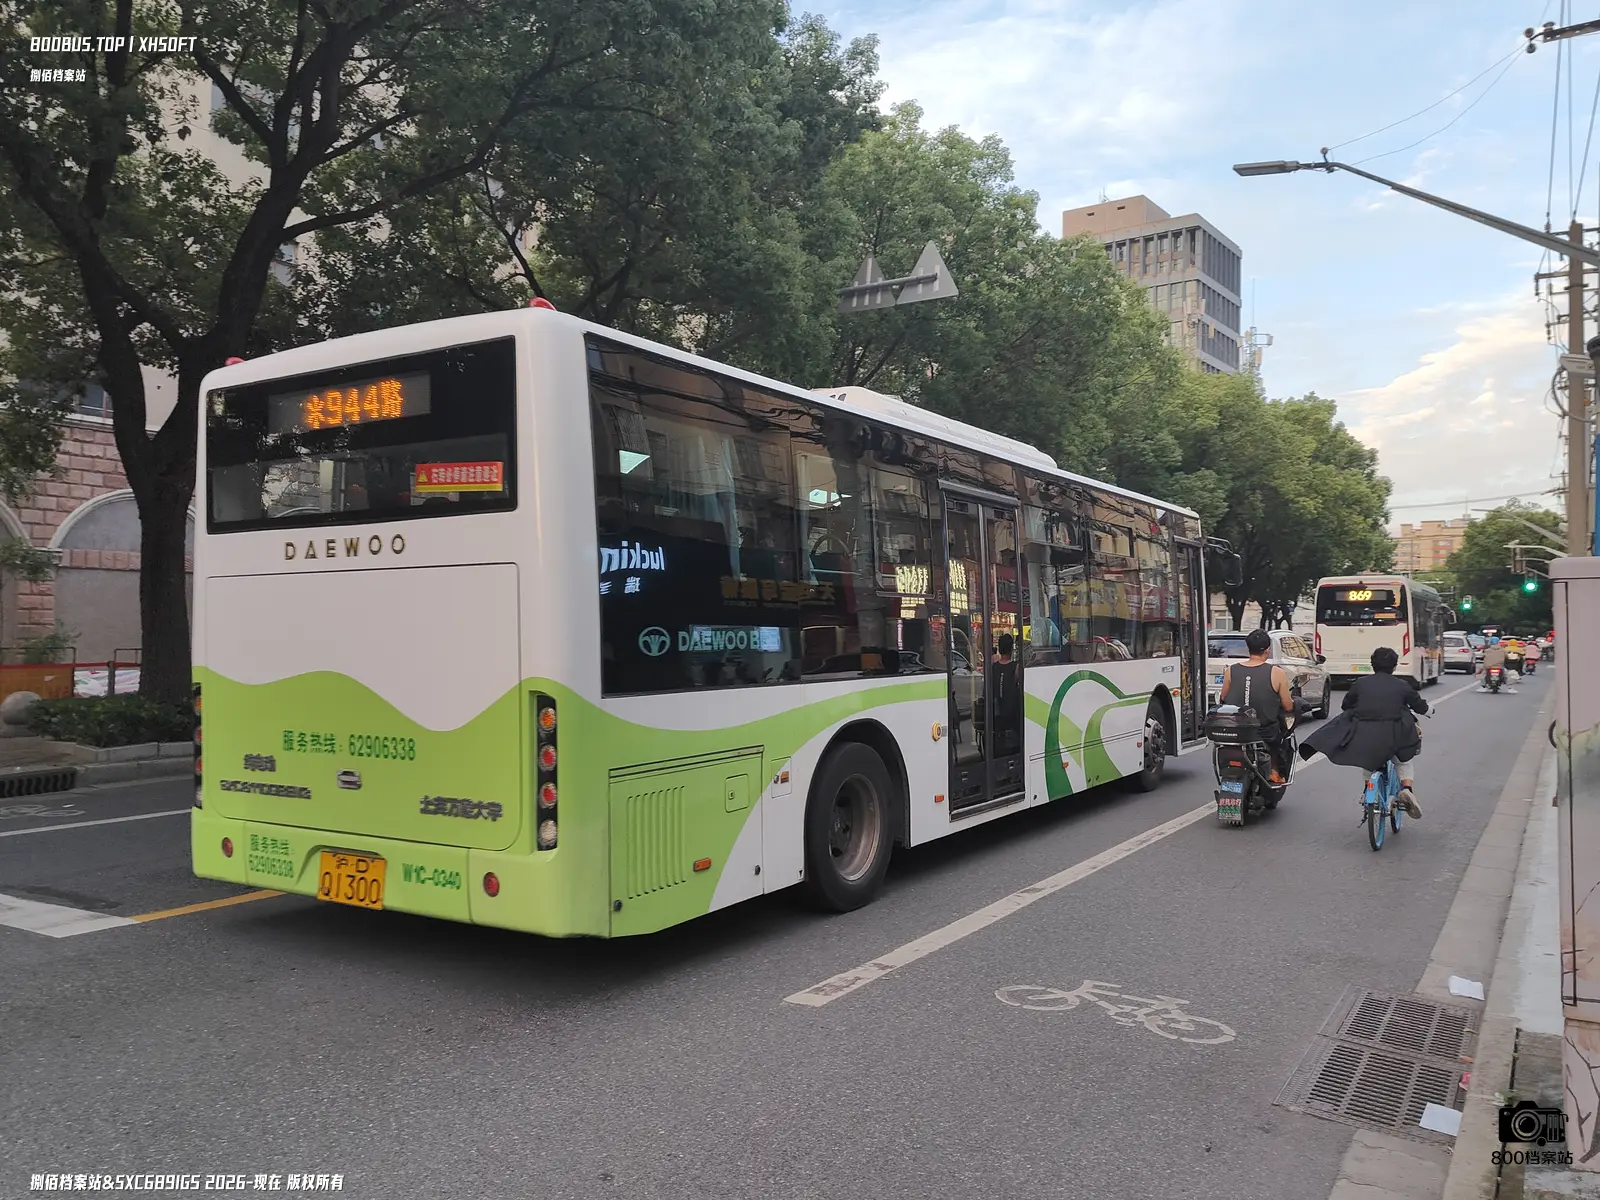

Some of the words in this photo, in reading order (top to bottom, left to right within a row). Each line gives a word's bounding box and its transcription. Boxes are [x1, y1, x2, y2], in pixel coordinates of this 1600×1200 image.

[284, 533, 405, 560] DAEWOO
[1349, 590, 1372, 601] 869
[678, 630, 747, 651] DAEWOO
[349, 734, 415, 761] 62906338
